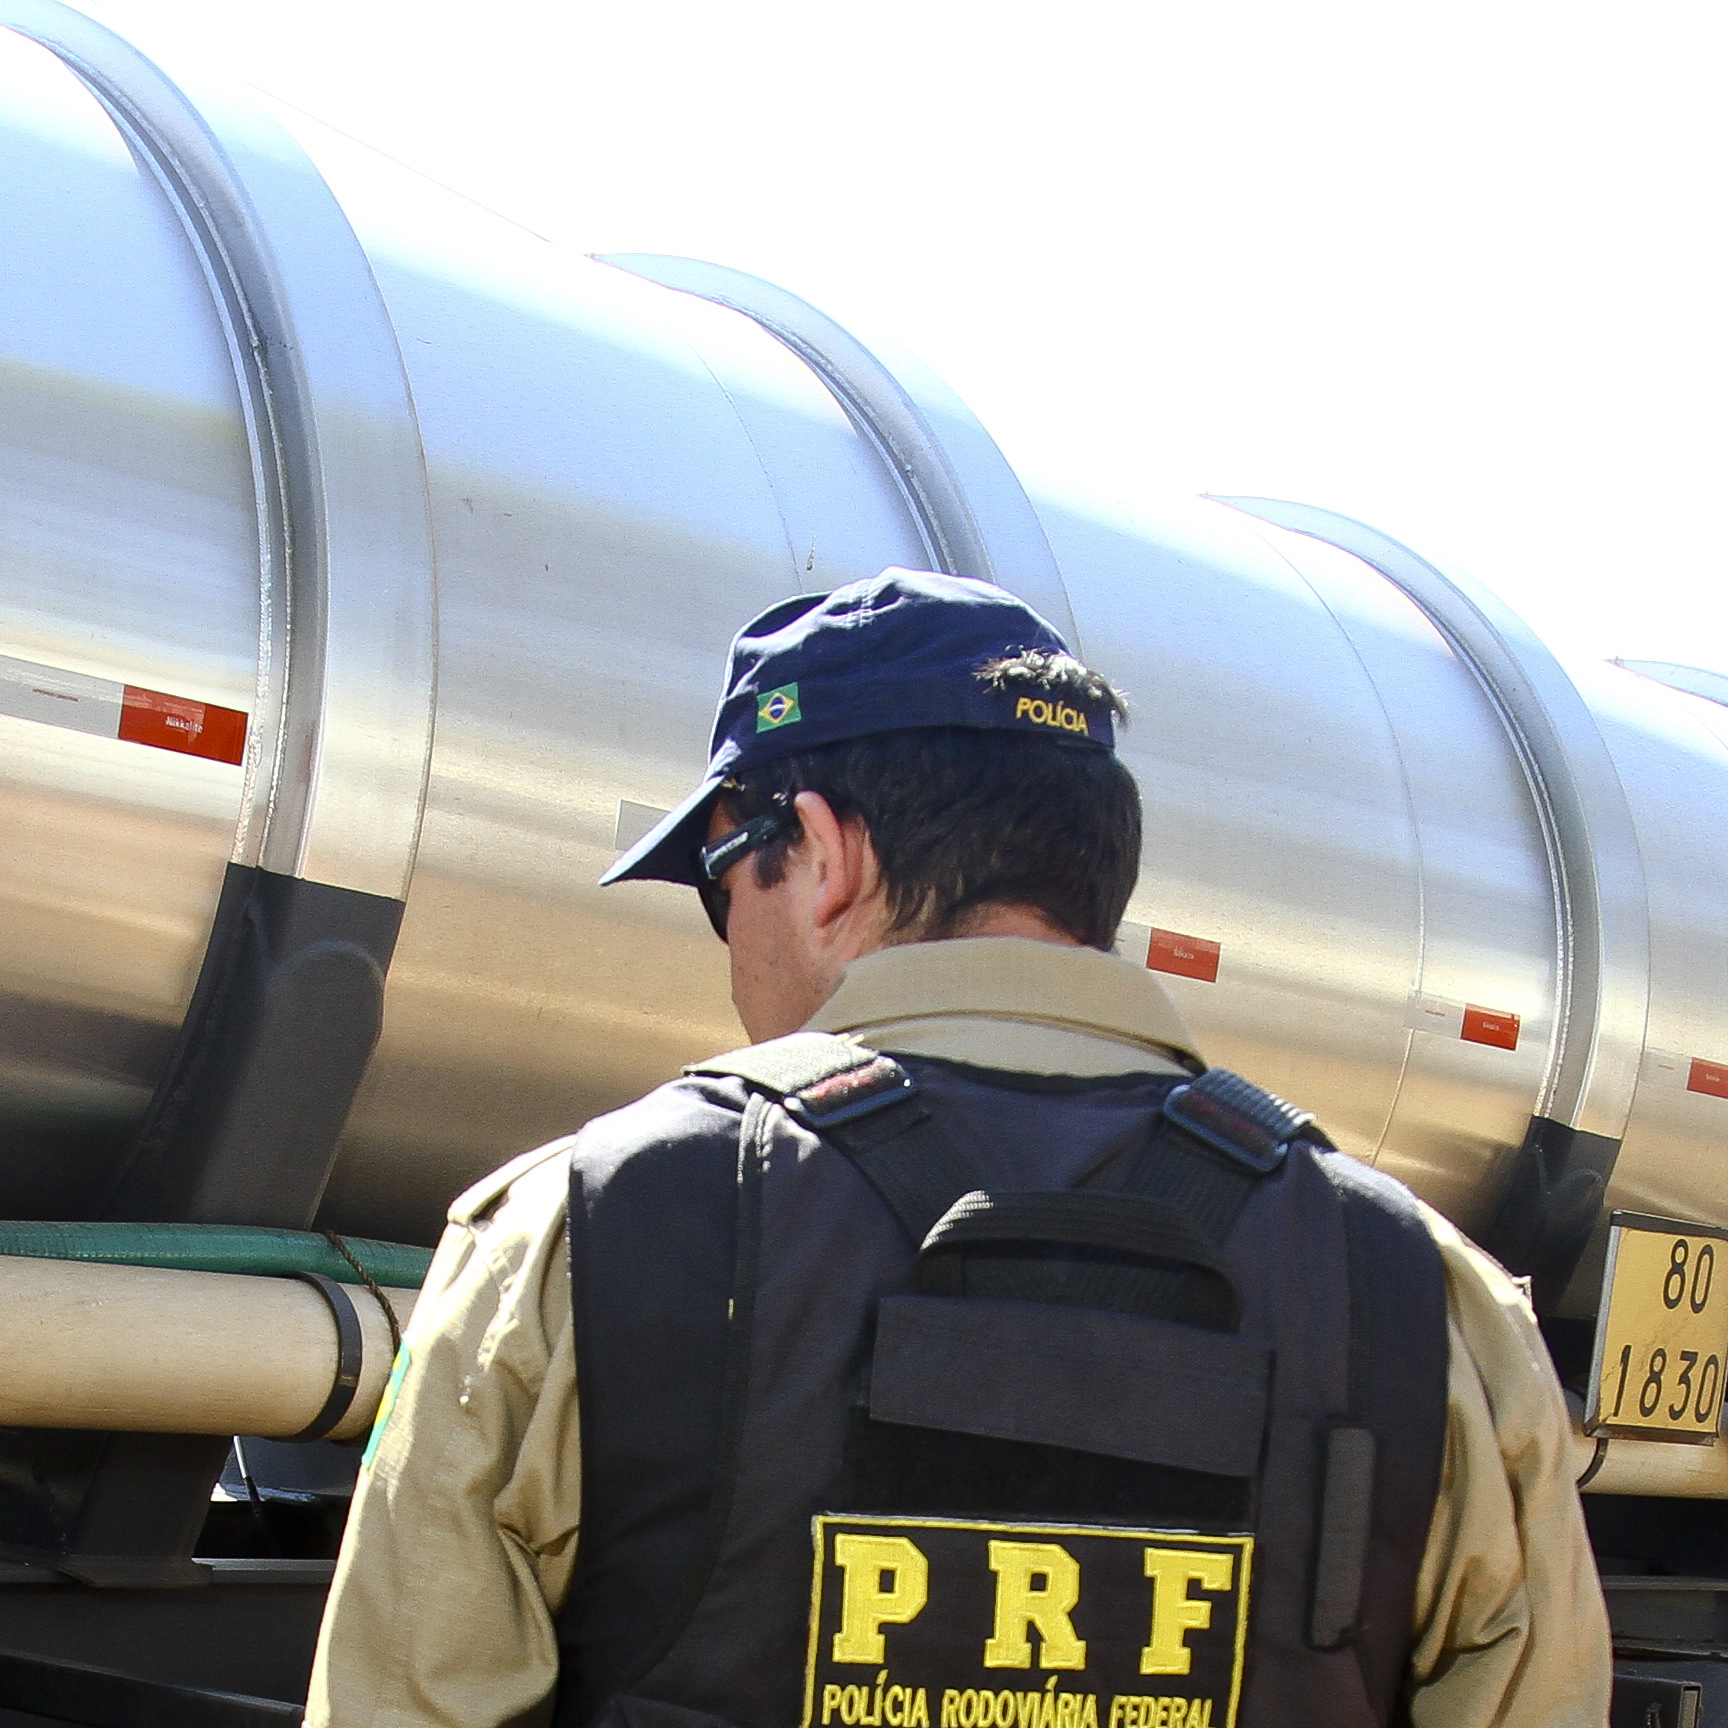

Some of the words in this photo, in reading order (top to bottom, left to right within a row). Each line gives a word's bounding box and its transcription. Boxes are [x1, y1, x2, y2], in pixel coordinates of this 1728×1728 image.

[1015, 697, 1090, 736] POLÍCIA
[1663, 1238, 1715, 1315] 80
[1612, 1344, 1719, 1424] 1830
[822, 1669, 929, 1728] POLÍCIA
